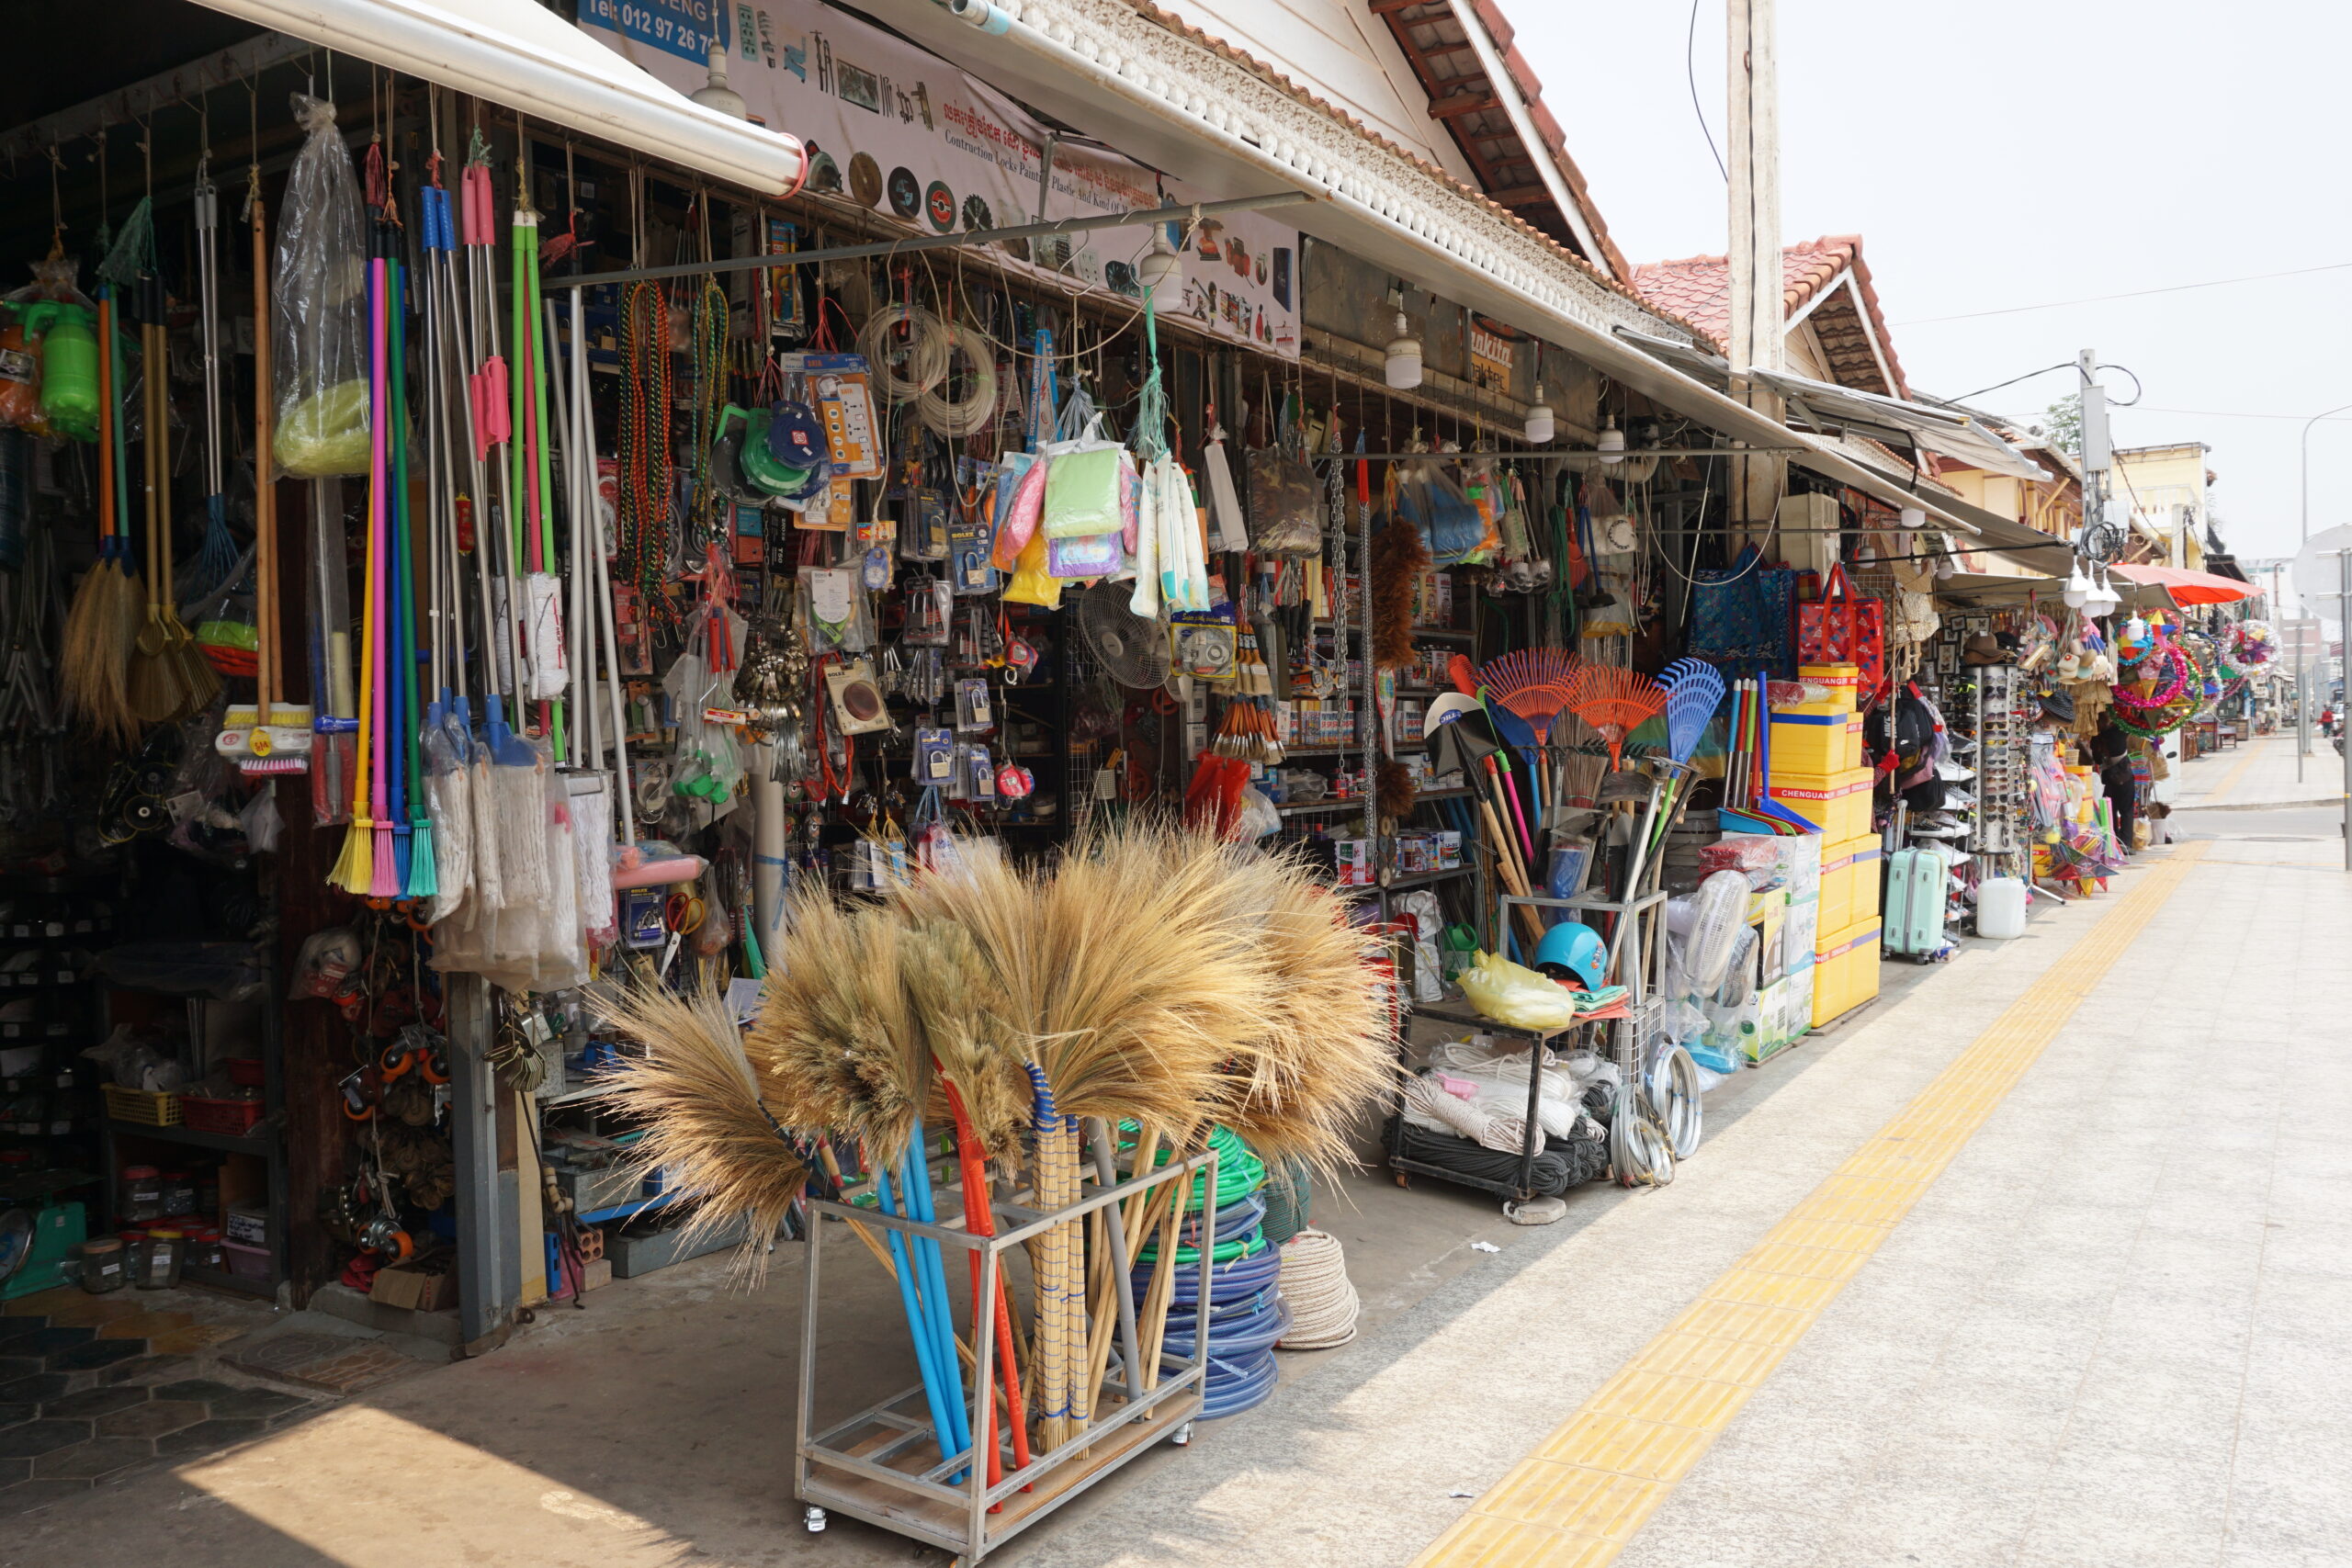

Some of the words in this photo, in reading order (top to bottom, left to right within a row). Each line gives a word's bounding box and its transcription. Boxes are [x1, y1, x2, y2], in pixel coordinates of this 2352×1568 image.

[622, 4, 651, 34] 012
[655, 17, 673, 41] 97
[677, 25, 695, 51] 26
[944, 129, 993, 163] Contruction
[995, 151, 1017, 174] Locks
[1052, 175, 1074, 197] Plastic
[1076, 188, 1091, 204] And
[1093, 192, 1110, 211] Kind
[1111, 199, 1120, 215] Of
[1883, 716, 1892, 738] NIKE
